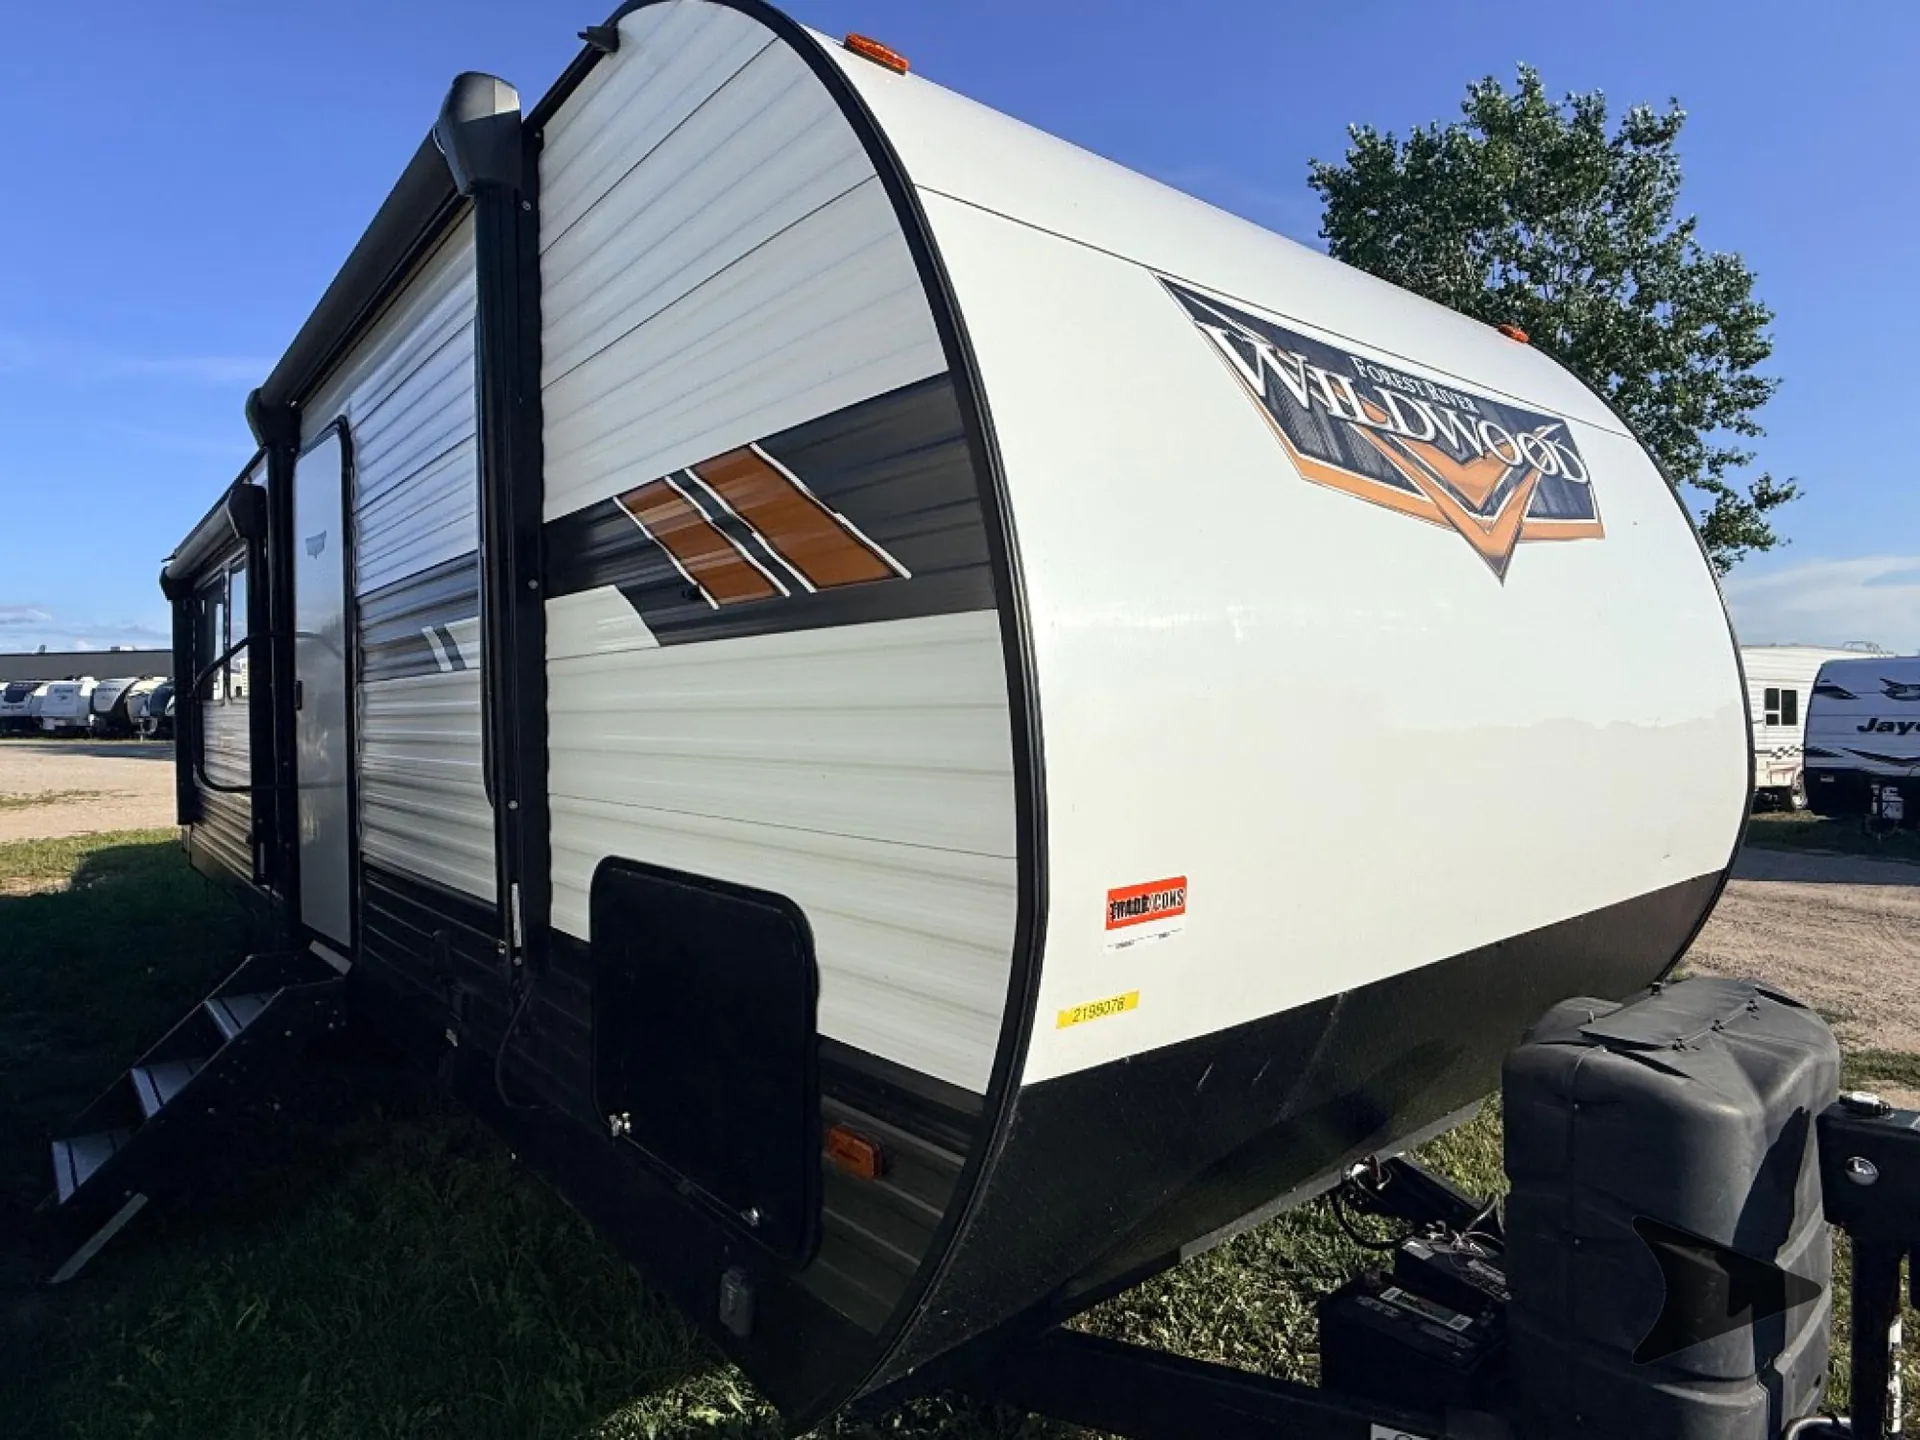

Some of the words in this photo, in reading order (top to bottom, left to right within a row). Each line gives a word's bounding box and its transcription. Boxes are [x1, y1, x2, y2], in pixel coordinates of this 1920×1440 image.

[1195, 321, 1588, 483] WILDWOOD
[1350, 356, 1426, 396] FOREST
[1421, 380, 1480, 413] RIVER
